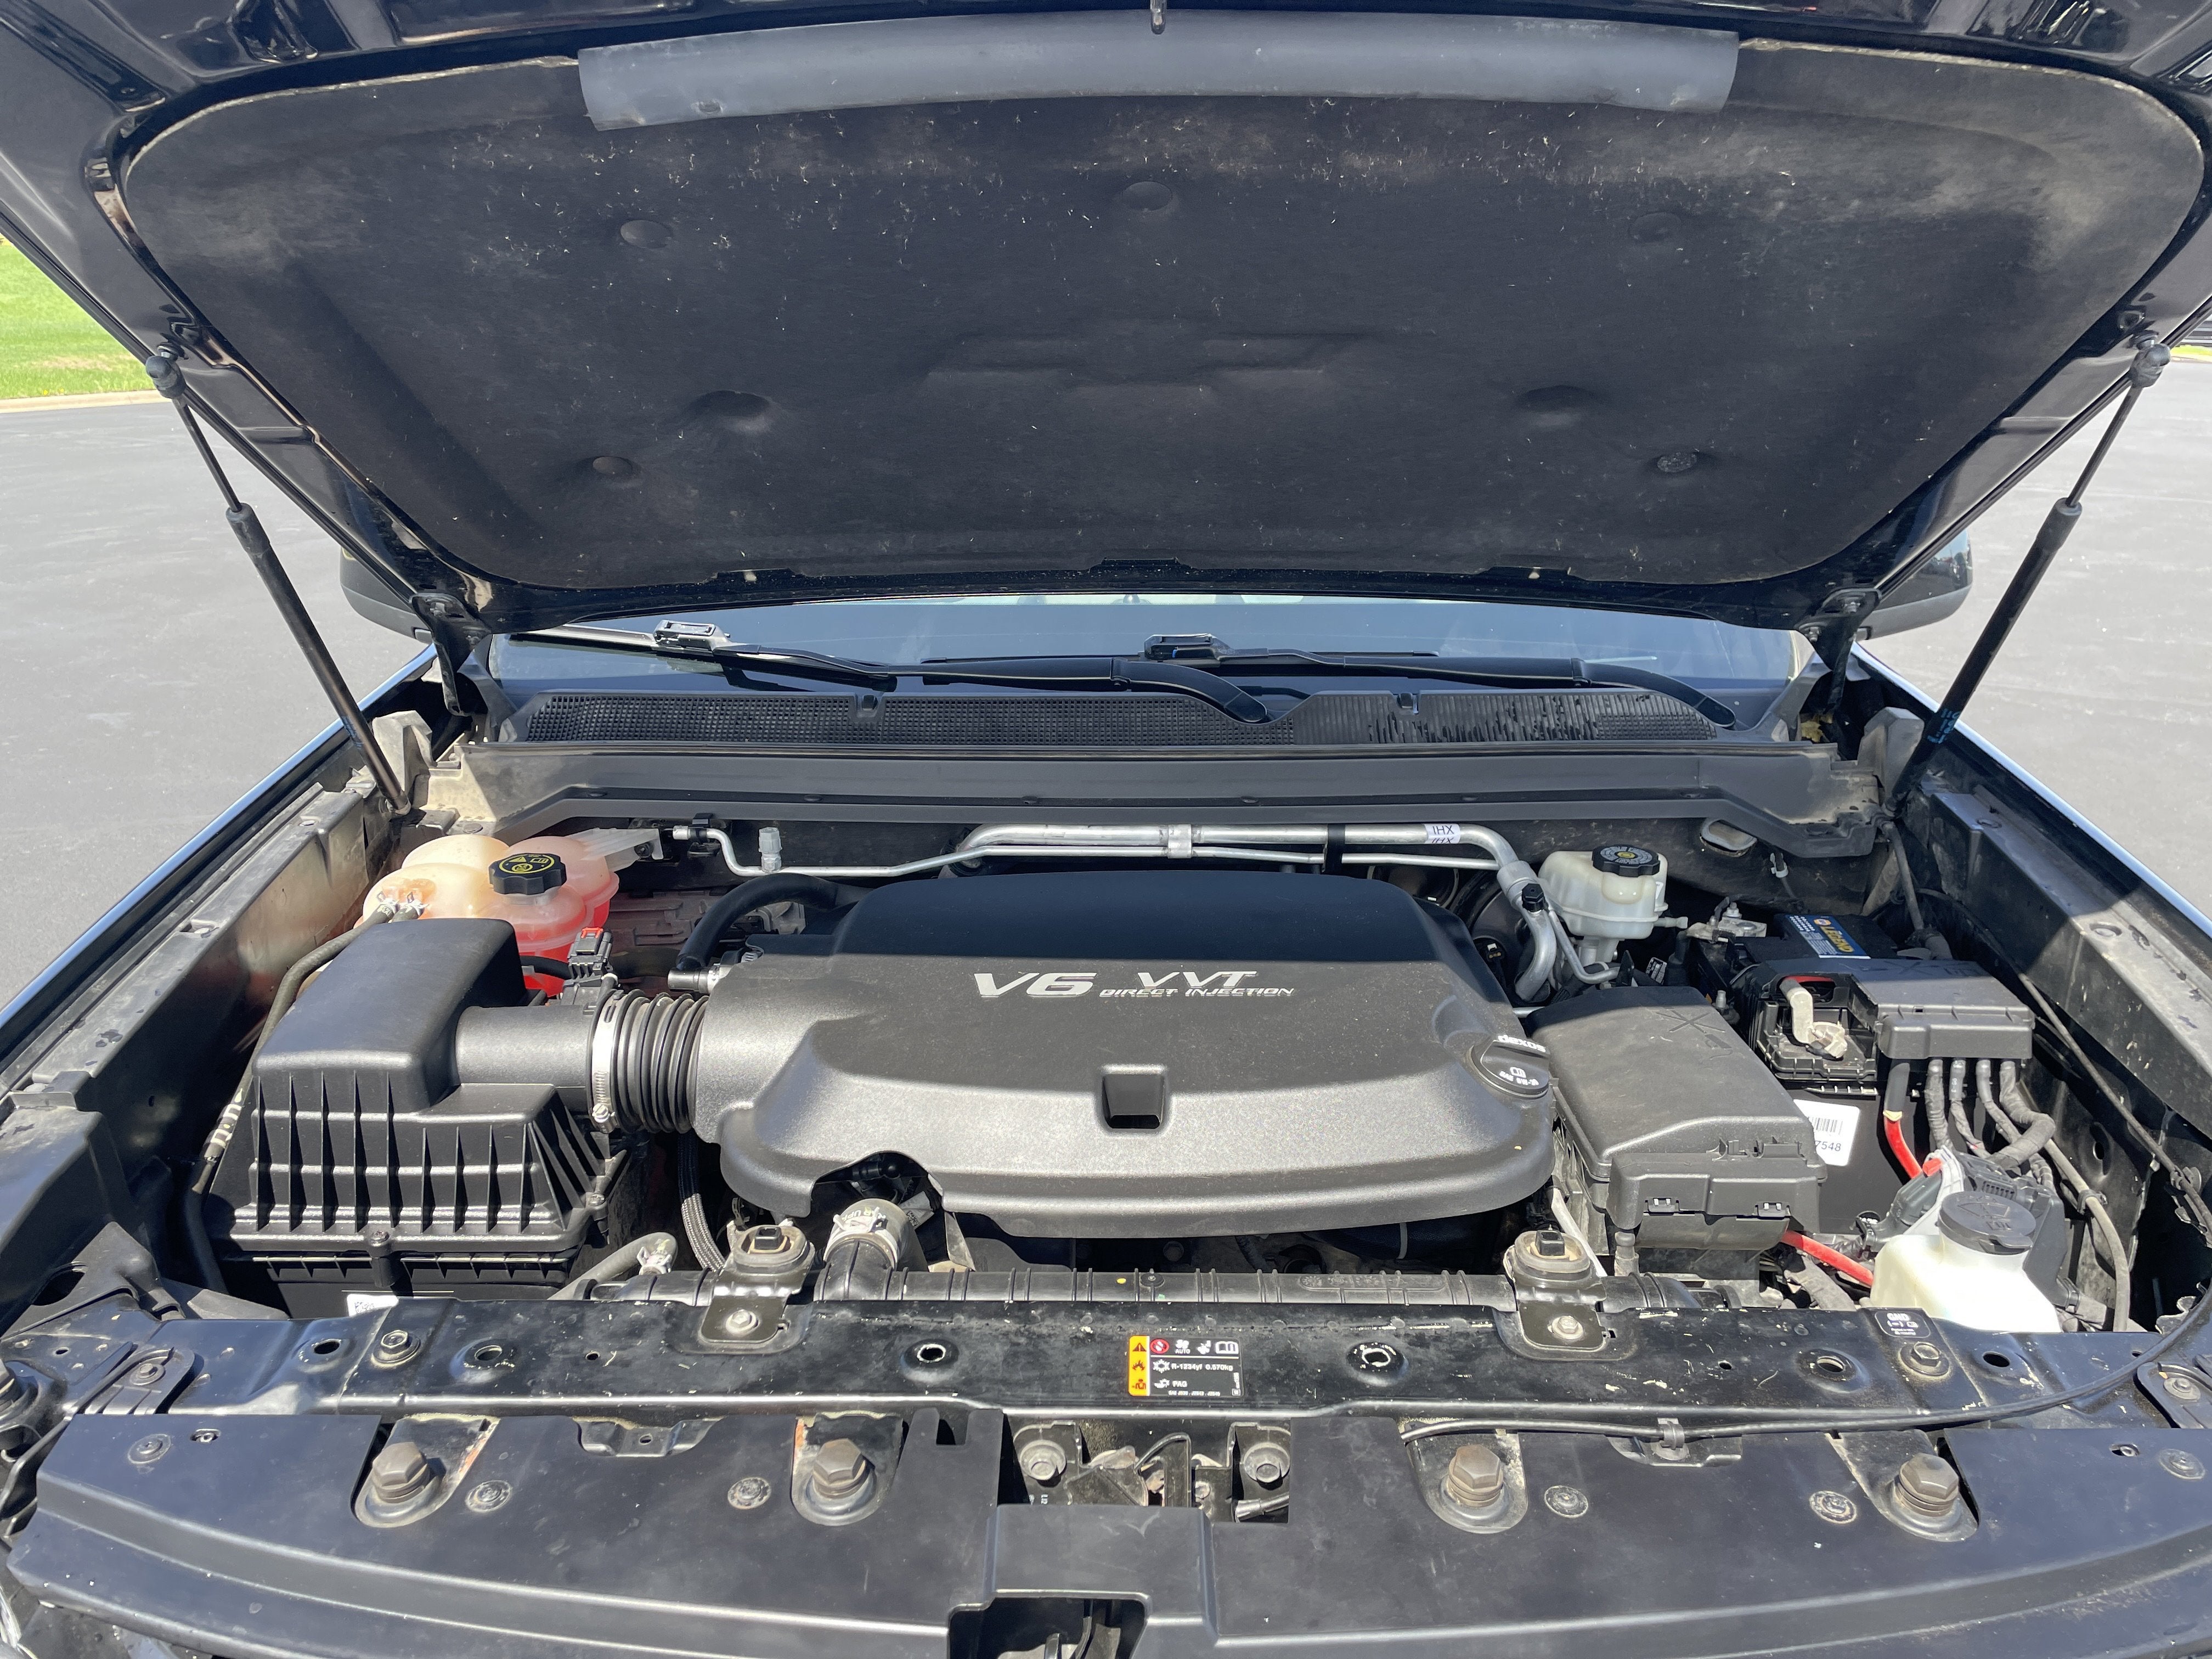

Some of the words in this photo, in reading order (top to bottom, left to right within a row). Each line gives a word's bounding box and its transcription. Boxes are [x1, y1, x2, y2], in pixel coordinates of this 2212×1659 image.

[1432, 825, 1454, 835] IHX
[973, 972, 1097, 996] V6
[1137, 970, 1257, 988] VVT
[1099, 988, 1178, 997] DIRECT
[1180, 988, 1295, 997] INJECTION
[1498, 1034, 1546, 1053] dexos
